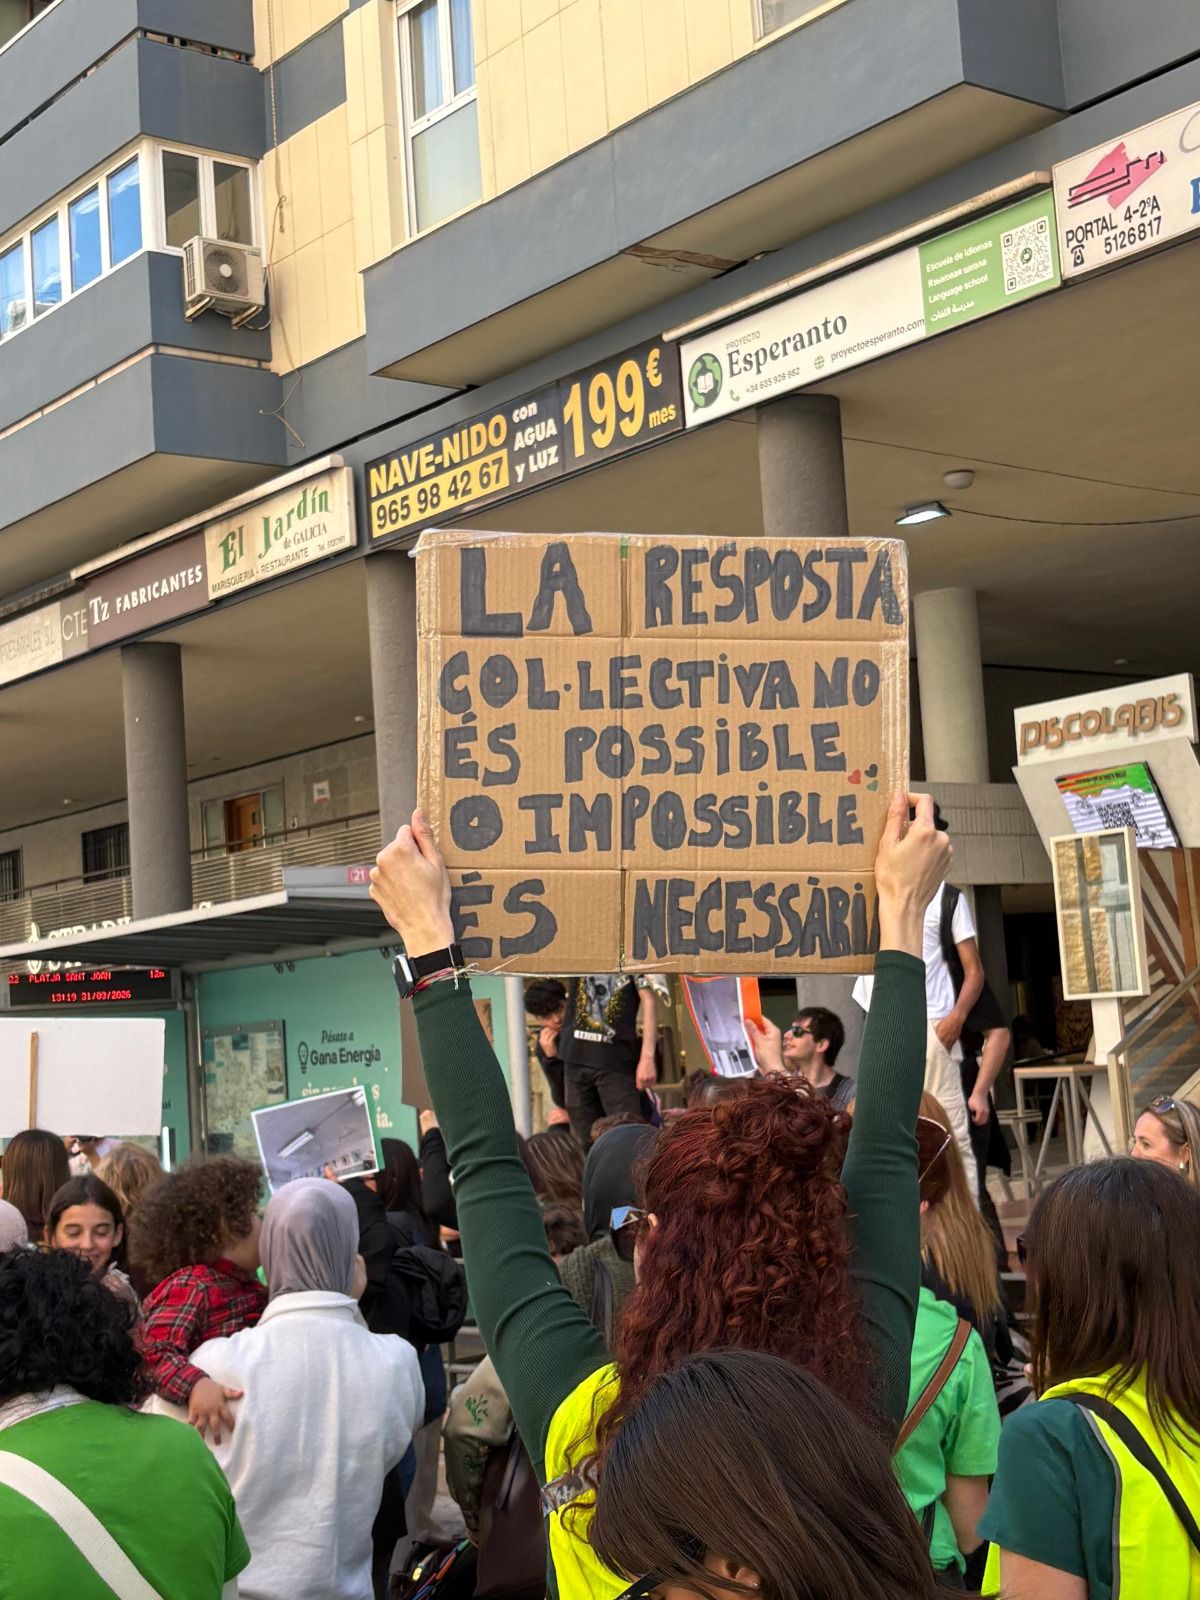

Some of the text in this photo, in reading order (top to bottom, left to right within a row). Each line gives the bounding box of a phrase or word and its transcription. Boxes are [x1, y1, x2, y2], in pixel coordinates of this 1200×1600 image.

[1066, 213, 1118, 248] PORTAL
[1104, 216, 1162, 254] 5126817
[926, 240, 992, 273] Escuela de idiomas
[928, 273, 988, 303] Language school
[726, 330, 761, 350] PROYECTO
[727, 315, 848, 378] Esperanto
[830, 318, 925, 363] proyectoesperanto.com
[512, 401, 538, 424] con
[649, 403, 676, 429] mes
[513, 418, 558, 451] AGUA
[370, 414, 508, 498] NAVE-NIDO
[515, 445, 559, 484] y LUZ
[376, 456, 504, 531] 965 98 42 67
[218, 485, 332, 575] El Jardín
[283, 522, 328, 550] de GALICIA
[116, 564, 203, 614] FABRICANTES
[211, 570, 256, 593] MARISQUERIA
[260, 547, 309, 575] RESTAURANTE
[460, 541, 904, 637] LA RESPOSTA
[813, 657, 880, 708] NO
[444, 711, 521, 787] ÉS
[450, 794, 503, 851] O
[450, 871, 558, 958] ÉS
[29, 973, 61, 983] PLATJA
[65, 972, 85, 982] SANT
[90, 971, 111, 981] JOAN
[51, 990, 131, 1003] 13:19 31/03/2026
[310, 1043, 381, 1068] Gana Energía
[321, 1029, 355, 1044] Pásate a
